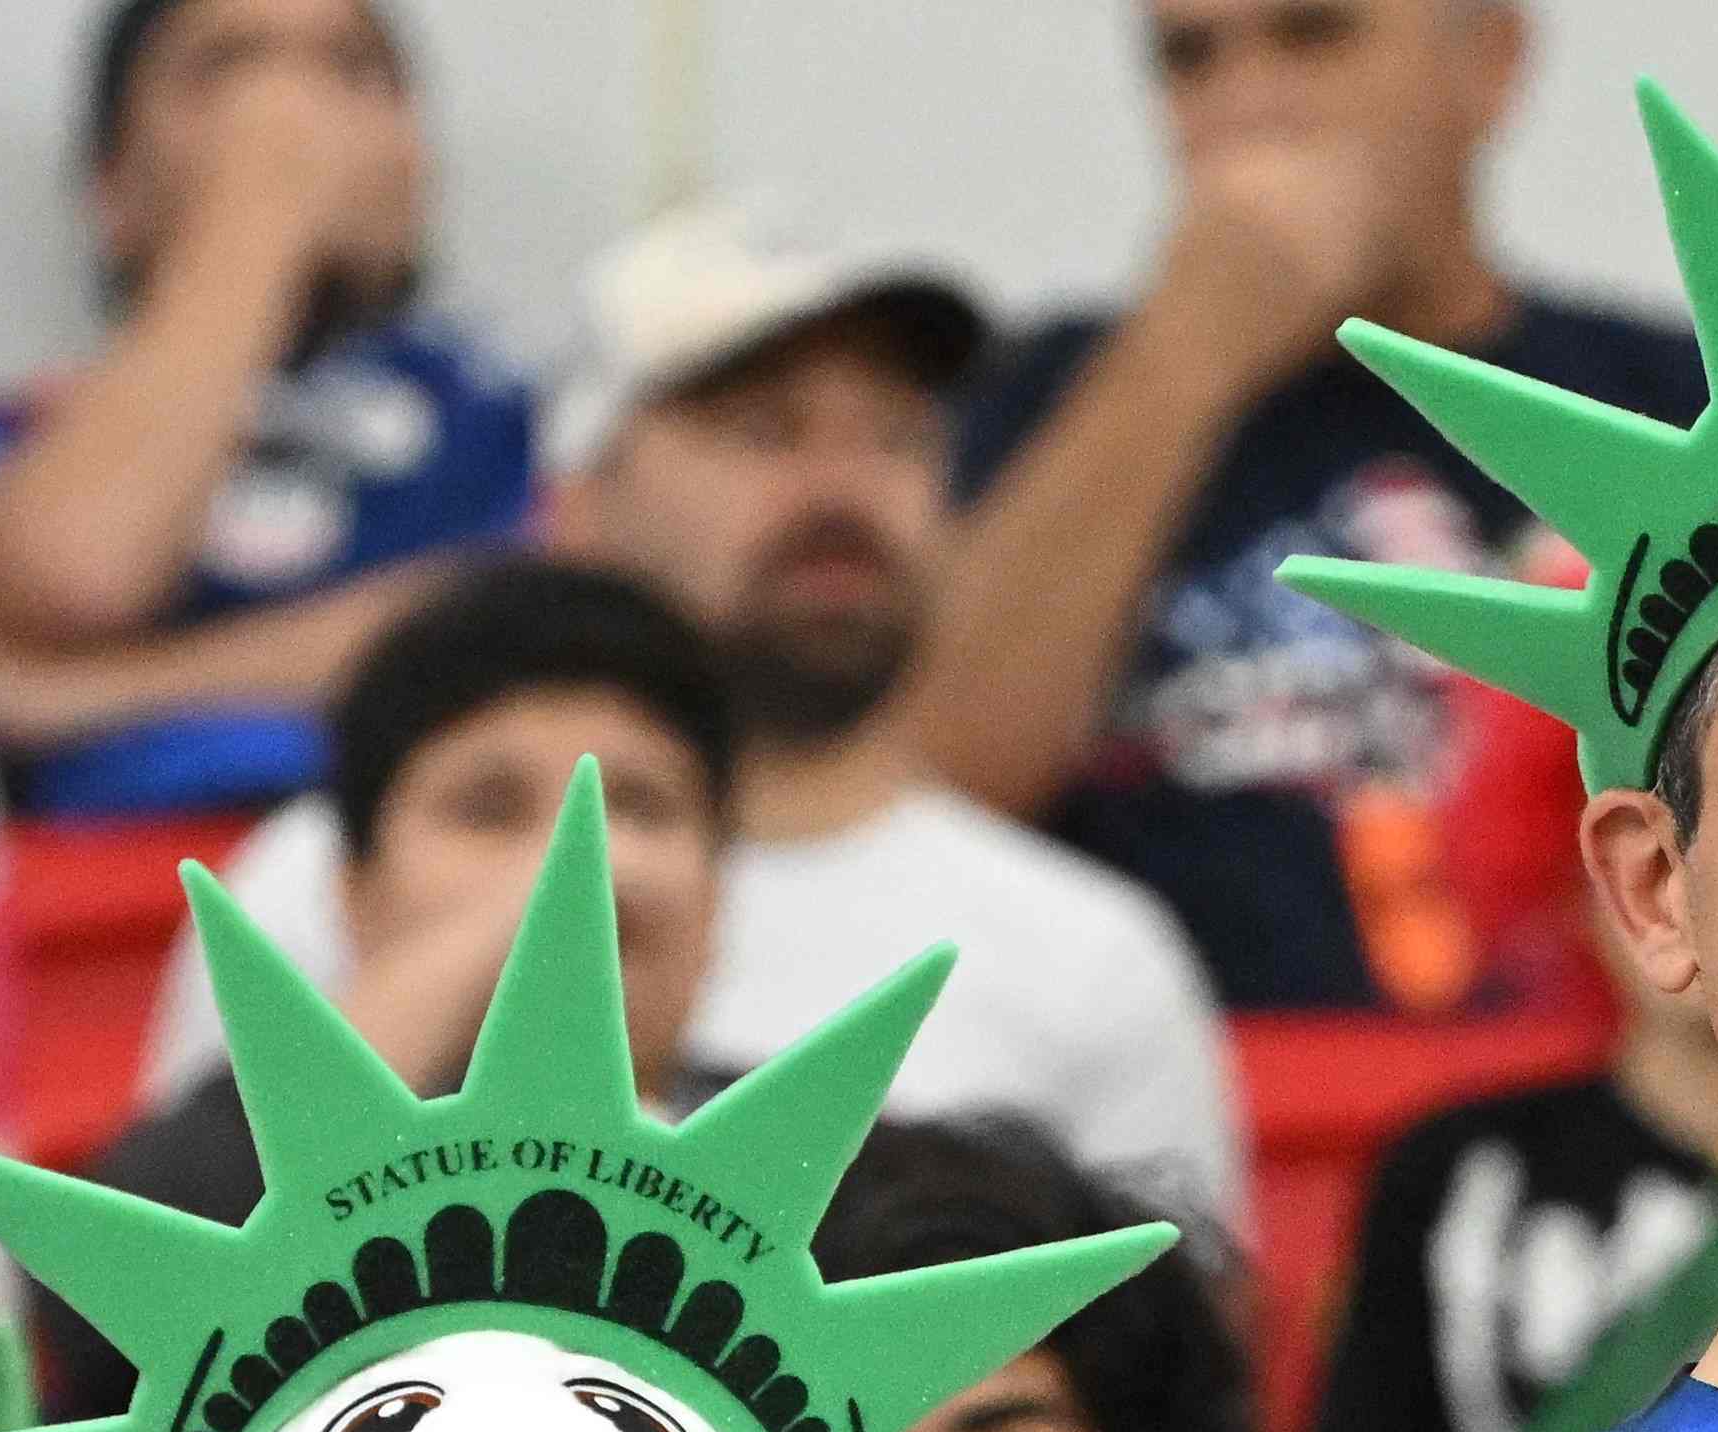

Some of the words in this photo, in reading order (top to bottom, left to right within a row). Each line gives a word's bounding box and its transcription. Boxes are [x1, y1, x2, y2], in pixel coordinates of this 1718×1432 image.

[325, 1138, 498, 1221] STATUE
[511, 1136, 576, 1172] OF
[586, 1148, 776, 1265] LIBERTY
